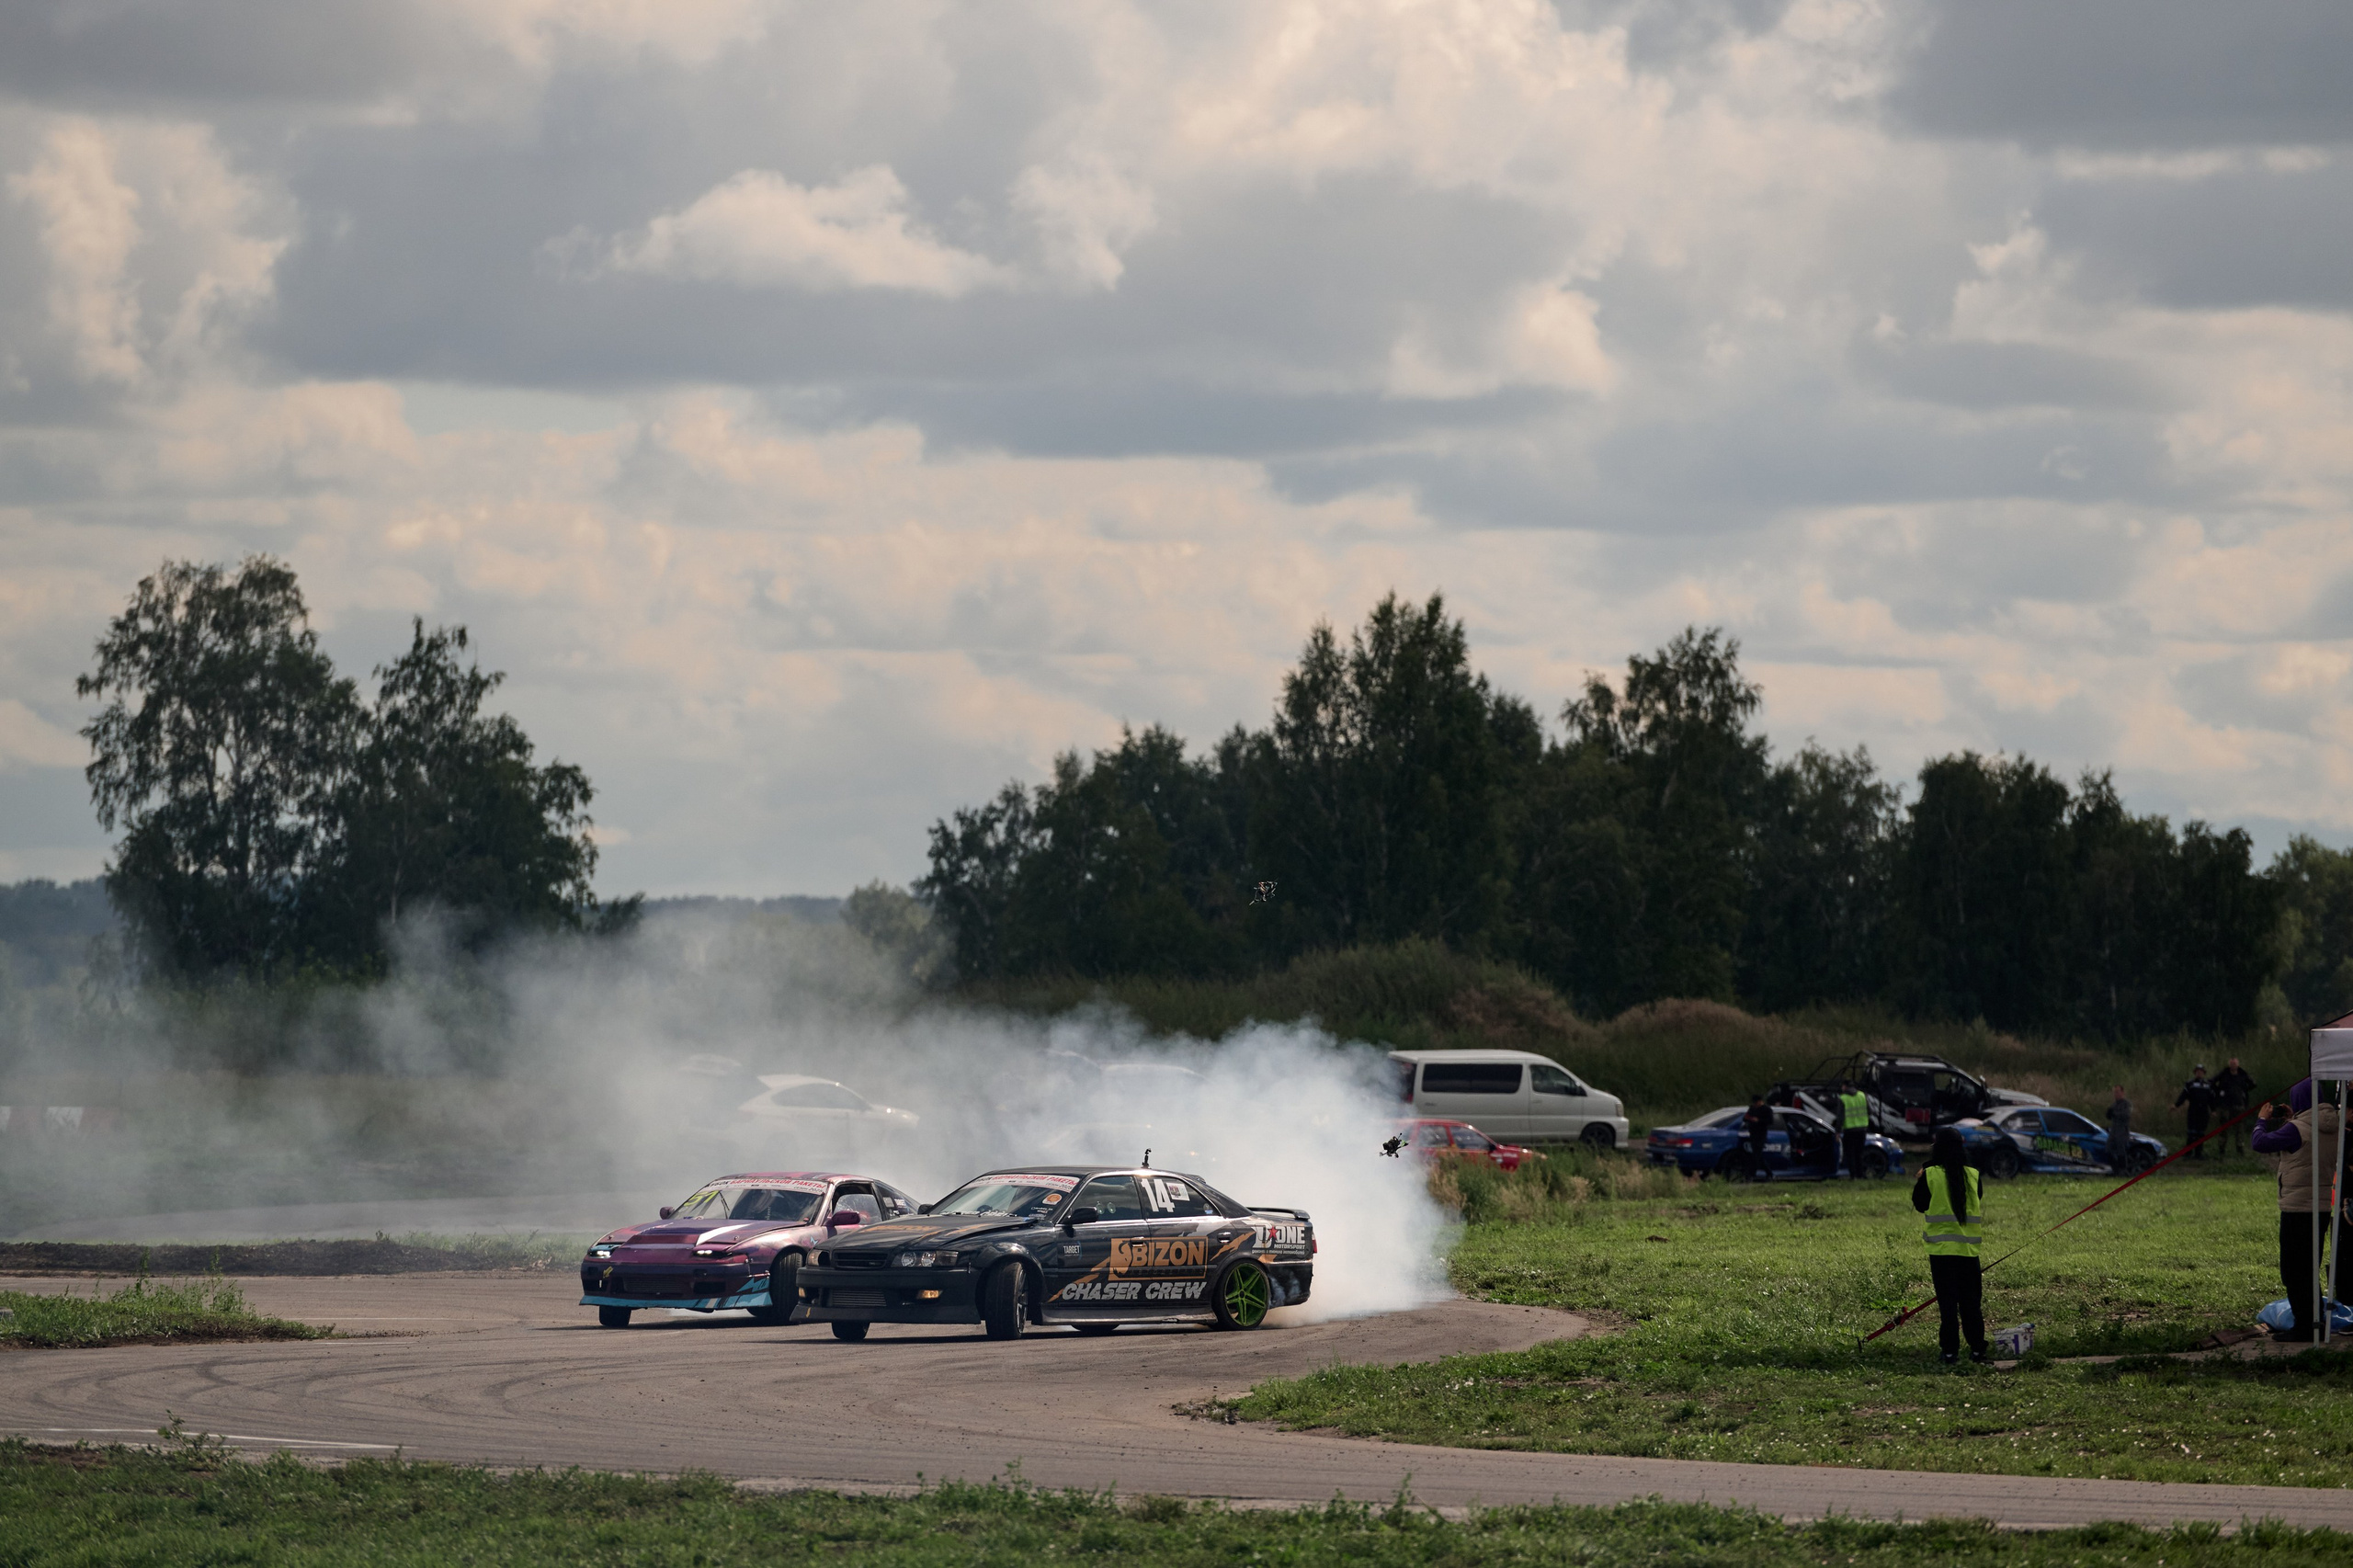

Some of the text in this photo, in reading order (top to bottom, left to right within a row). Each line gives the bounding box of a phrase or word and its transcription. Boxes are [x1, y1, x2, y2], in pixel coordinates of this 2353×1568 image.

[792, 1180, 827, 1188] РАКЕТЫ
[1141, 1178, 1176, 1212] 14
[1063, 1244, 1080, 1254] TARGET
[1131, 1241, 1205, 1267] BIZON
[1062, 1281, 1208, 1301] CHASER CREW
